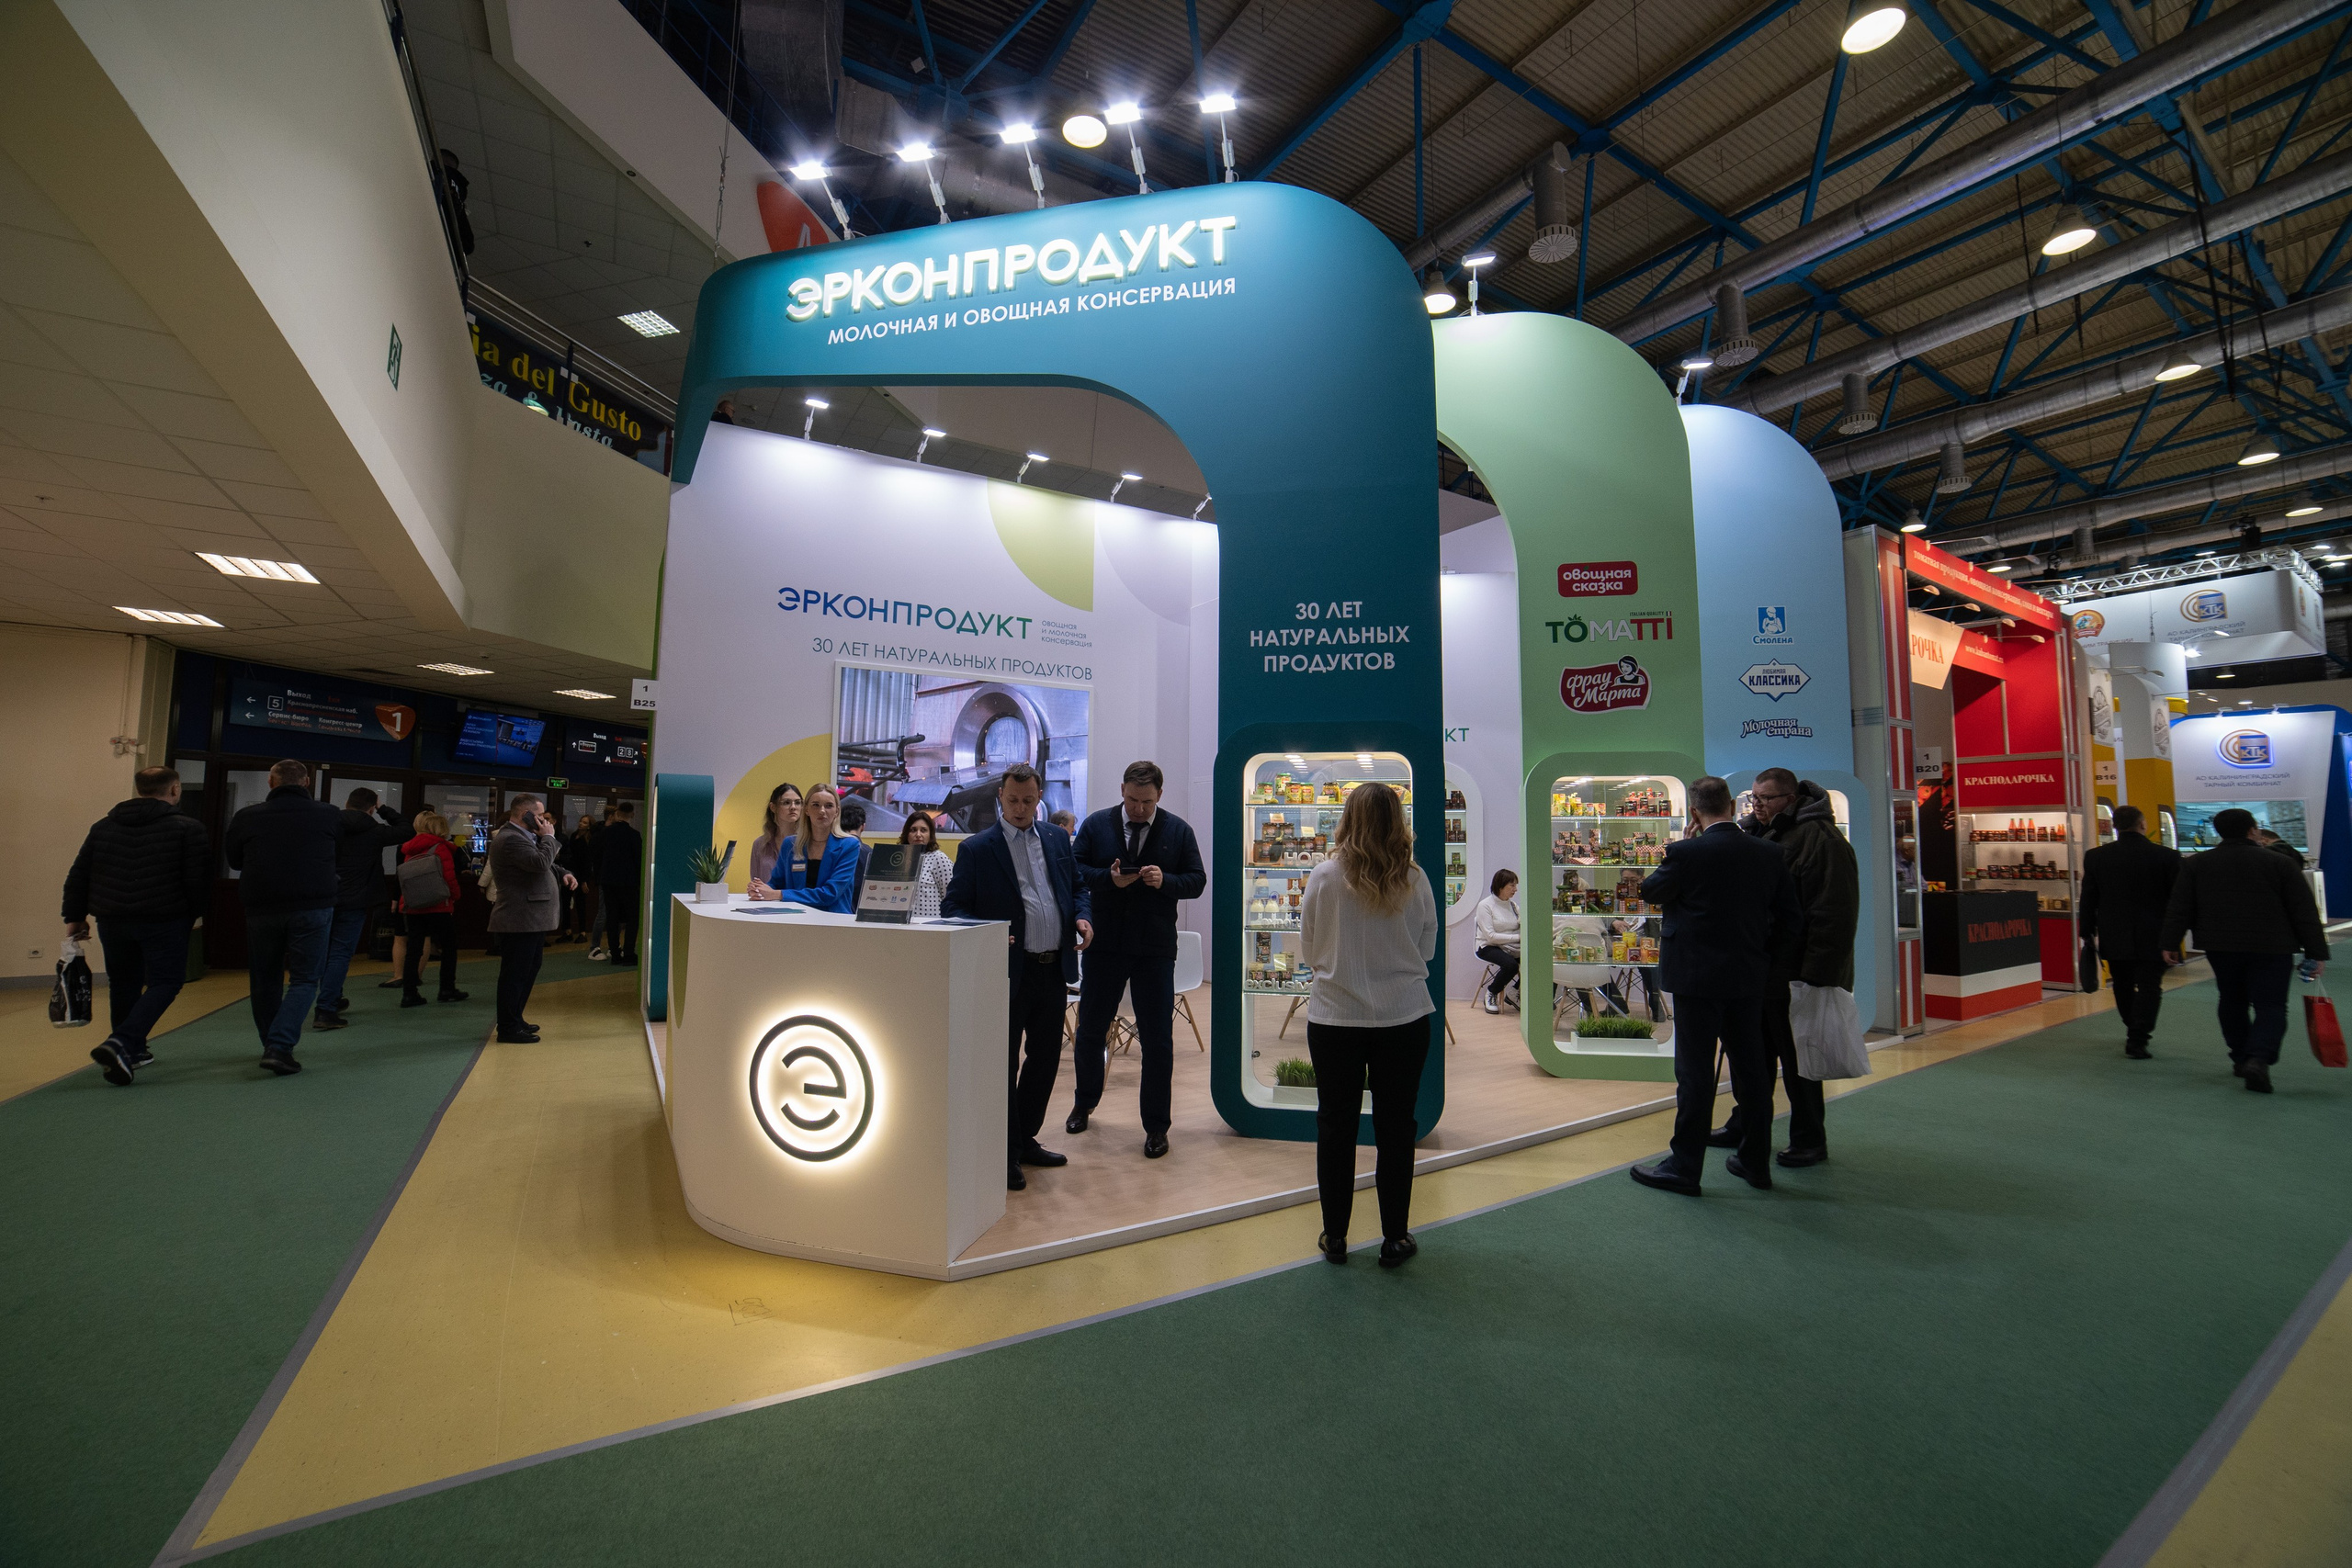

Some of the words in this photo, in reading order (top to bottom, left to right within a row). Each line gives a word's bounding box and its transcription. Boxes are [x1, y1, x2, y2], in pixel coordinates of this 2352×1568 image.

[786, 215, 1237, 321] ЭРКОНПРОДУКТ
[827, 314, 939, 346] МОЛОЧНАЯ
[944, 312, 957, 329] И
[963, 297, 1070, 326] ОВОЩНАЯ
[1077, 277, 1237, 312] КОНСЕРВАЦИЯ
[470, 324, 501, 367] ia
[511, 352, 555, 397] del
[569, 380, 642, 441] Gusto
[557, 406, 614, 448] asta
[1562, 568, 1632, 582] овощная
[1572, 581, 1623, 593] сказка
[777, 586, 1033, 639] ЭРКОНПРОДУКТ
[1295, 602, 1320, 620] 30
[1326, 601, 1363, 619] ЛЕТ
[1250, 626, 1410, 647] НАТУРАЛЬНЫХ
[1910, 634, 1944, 664] РОЧКА
[812, 637, 833, 654] 30
[838, 640, 869, 658] ЛЕТ
[874, 647, 997, 671] НАТУРАЛЬНЫХ
[1001, 658, 1093, 681] ПРОДУКТОВ
[1263, 652, 1396, 673] ПРОДУКТОВ
[1748, 675, 1801, 686] КЛАССИКА
[272, 699, 280, 708] 5
[287, 689, 311, 700] Выход
[633, 699, 656, 707] B25
[1573, 686, 1641, 708] Марта
[267, 711, 310, 722] Сервис-бюро
[318, 716, 363, 728] Конгресс-центр
[391, 712, 402, 732] 1
[1742, 719, 1796, 738] Молочная
[1445, 728, 1470, 742] КТ
[1916, 764, 1939, 773] B20
[1964, 773, 2055, 786] КРАСНОДАРОЧКА
[1967, 919, 2033, 943] КРАСНОДАРОЧКА
